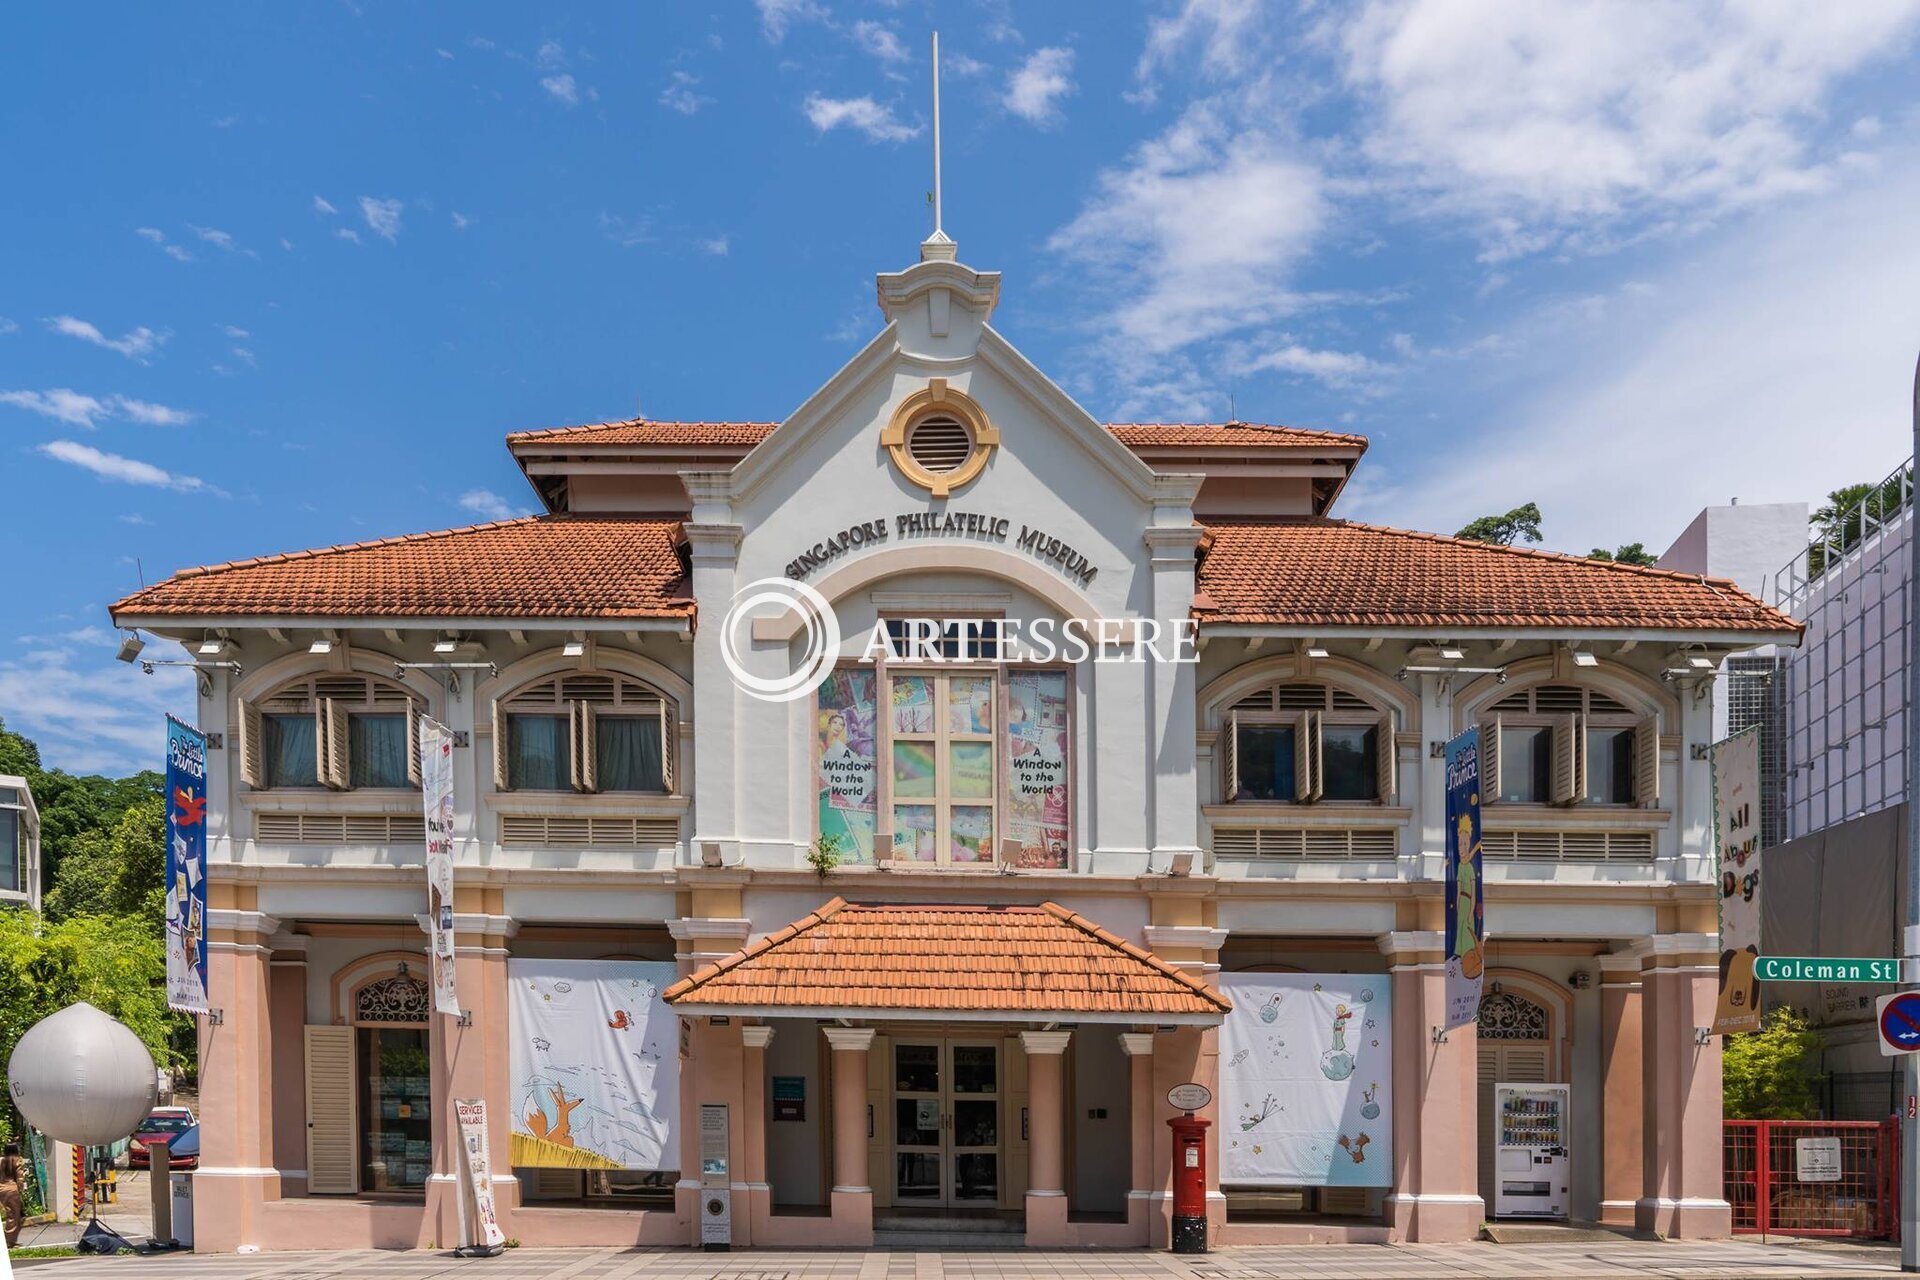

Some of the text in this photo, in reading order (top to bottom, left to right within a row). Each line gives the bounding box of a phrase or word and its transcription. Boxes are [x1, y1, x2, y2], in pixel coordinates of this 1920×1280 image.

[785, 512, 1098, 584] SINGAPORE PHILATELIC MUSEUM
[843, 750, 851, 759] A
[1033, 748, 1041, 757] A
[171, 739, 203, 779] Prince
[823, 761, 872, 772] Window
[1013, 759, 1062, 770] Window
[830, 774, 864, 784] to the
[1021, 772, 1054, 782] to the
[832, 786, 863, 796] World
[1022, 784, 1054, 794] World
[1731, 803, 1749, 832] All
[1724, 836, 1758, 868] About
[1766, 960, 1892, 979] Coleman St
[459, 1105, 483, 1115] SERVICES
[461, 1115, 483, 1125] AVAILABLE
